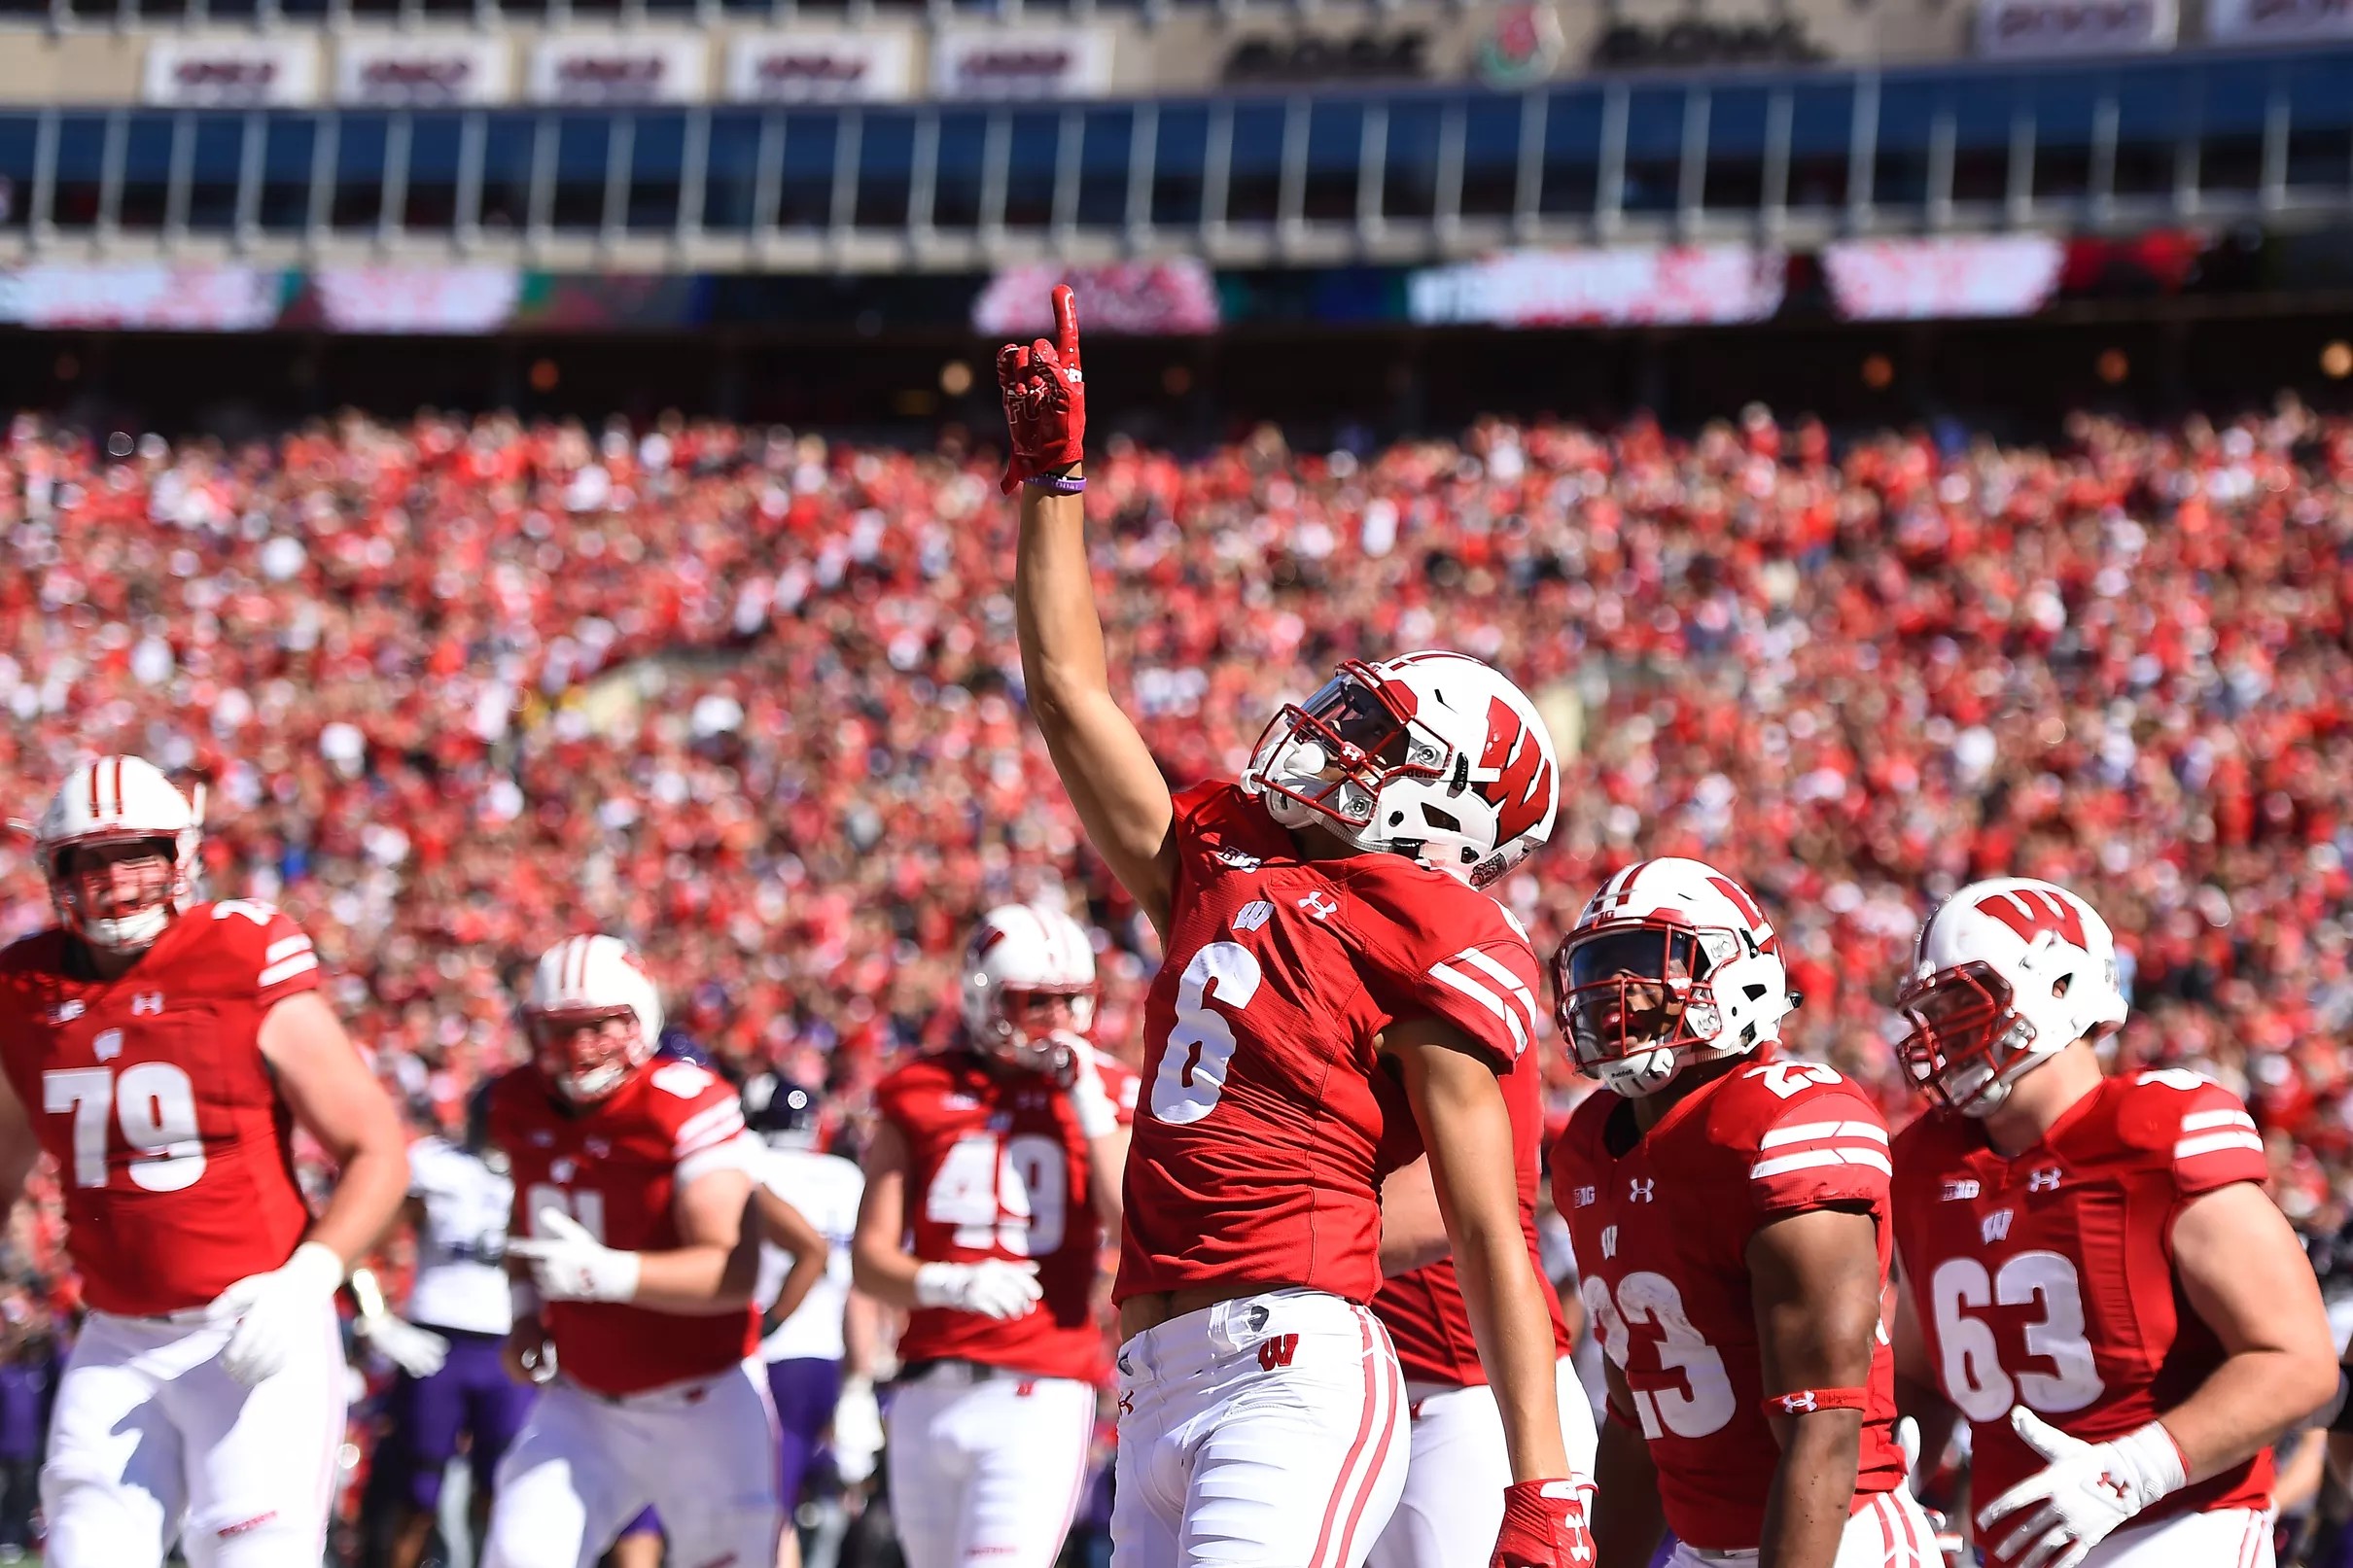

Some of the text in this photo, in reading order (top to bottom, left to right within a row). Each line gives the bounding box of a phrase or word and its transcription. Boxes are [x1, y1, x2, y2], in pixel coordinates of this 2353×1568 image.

[1471, 695, 1553, 850] W
[1232, 900, 1275, 932] W
[1975, 889, 2089, 954] W
[1150, 941, 1261, 1126] 6
[43, 1062, 207, 1193] 79
[926, 1133, 1067, 1256] 49
[1600, 1225, 1619, 1260] W
[1982, 1208, 2015, 1245] W
[1258, 1333, 1299, 1372] W
[1583, 1271, 1738, 1440] 23
[1932, 1250, 2105, 1423] 63
